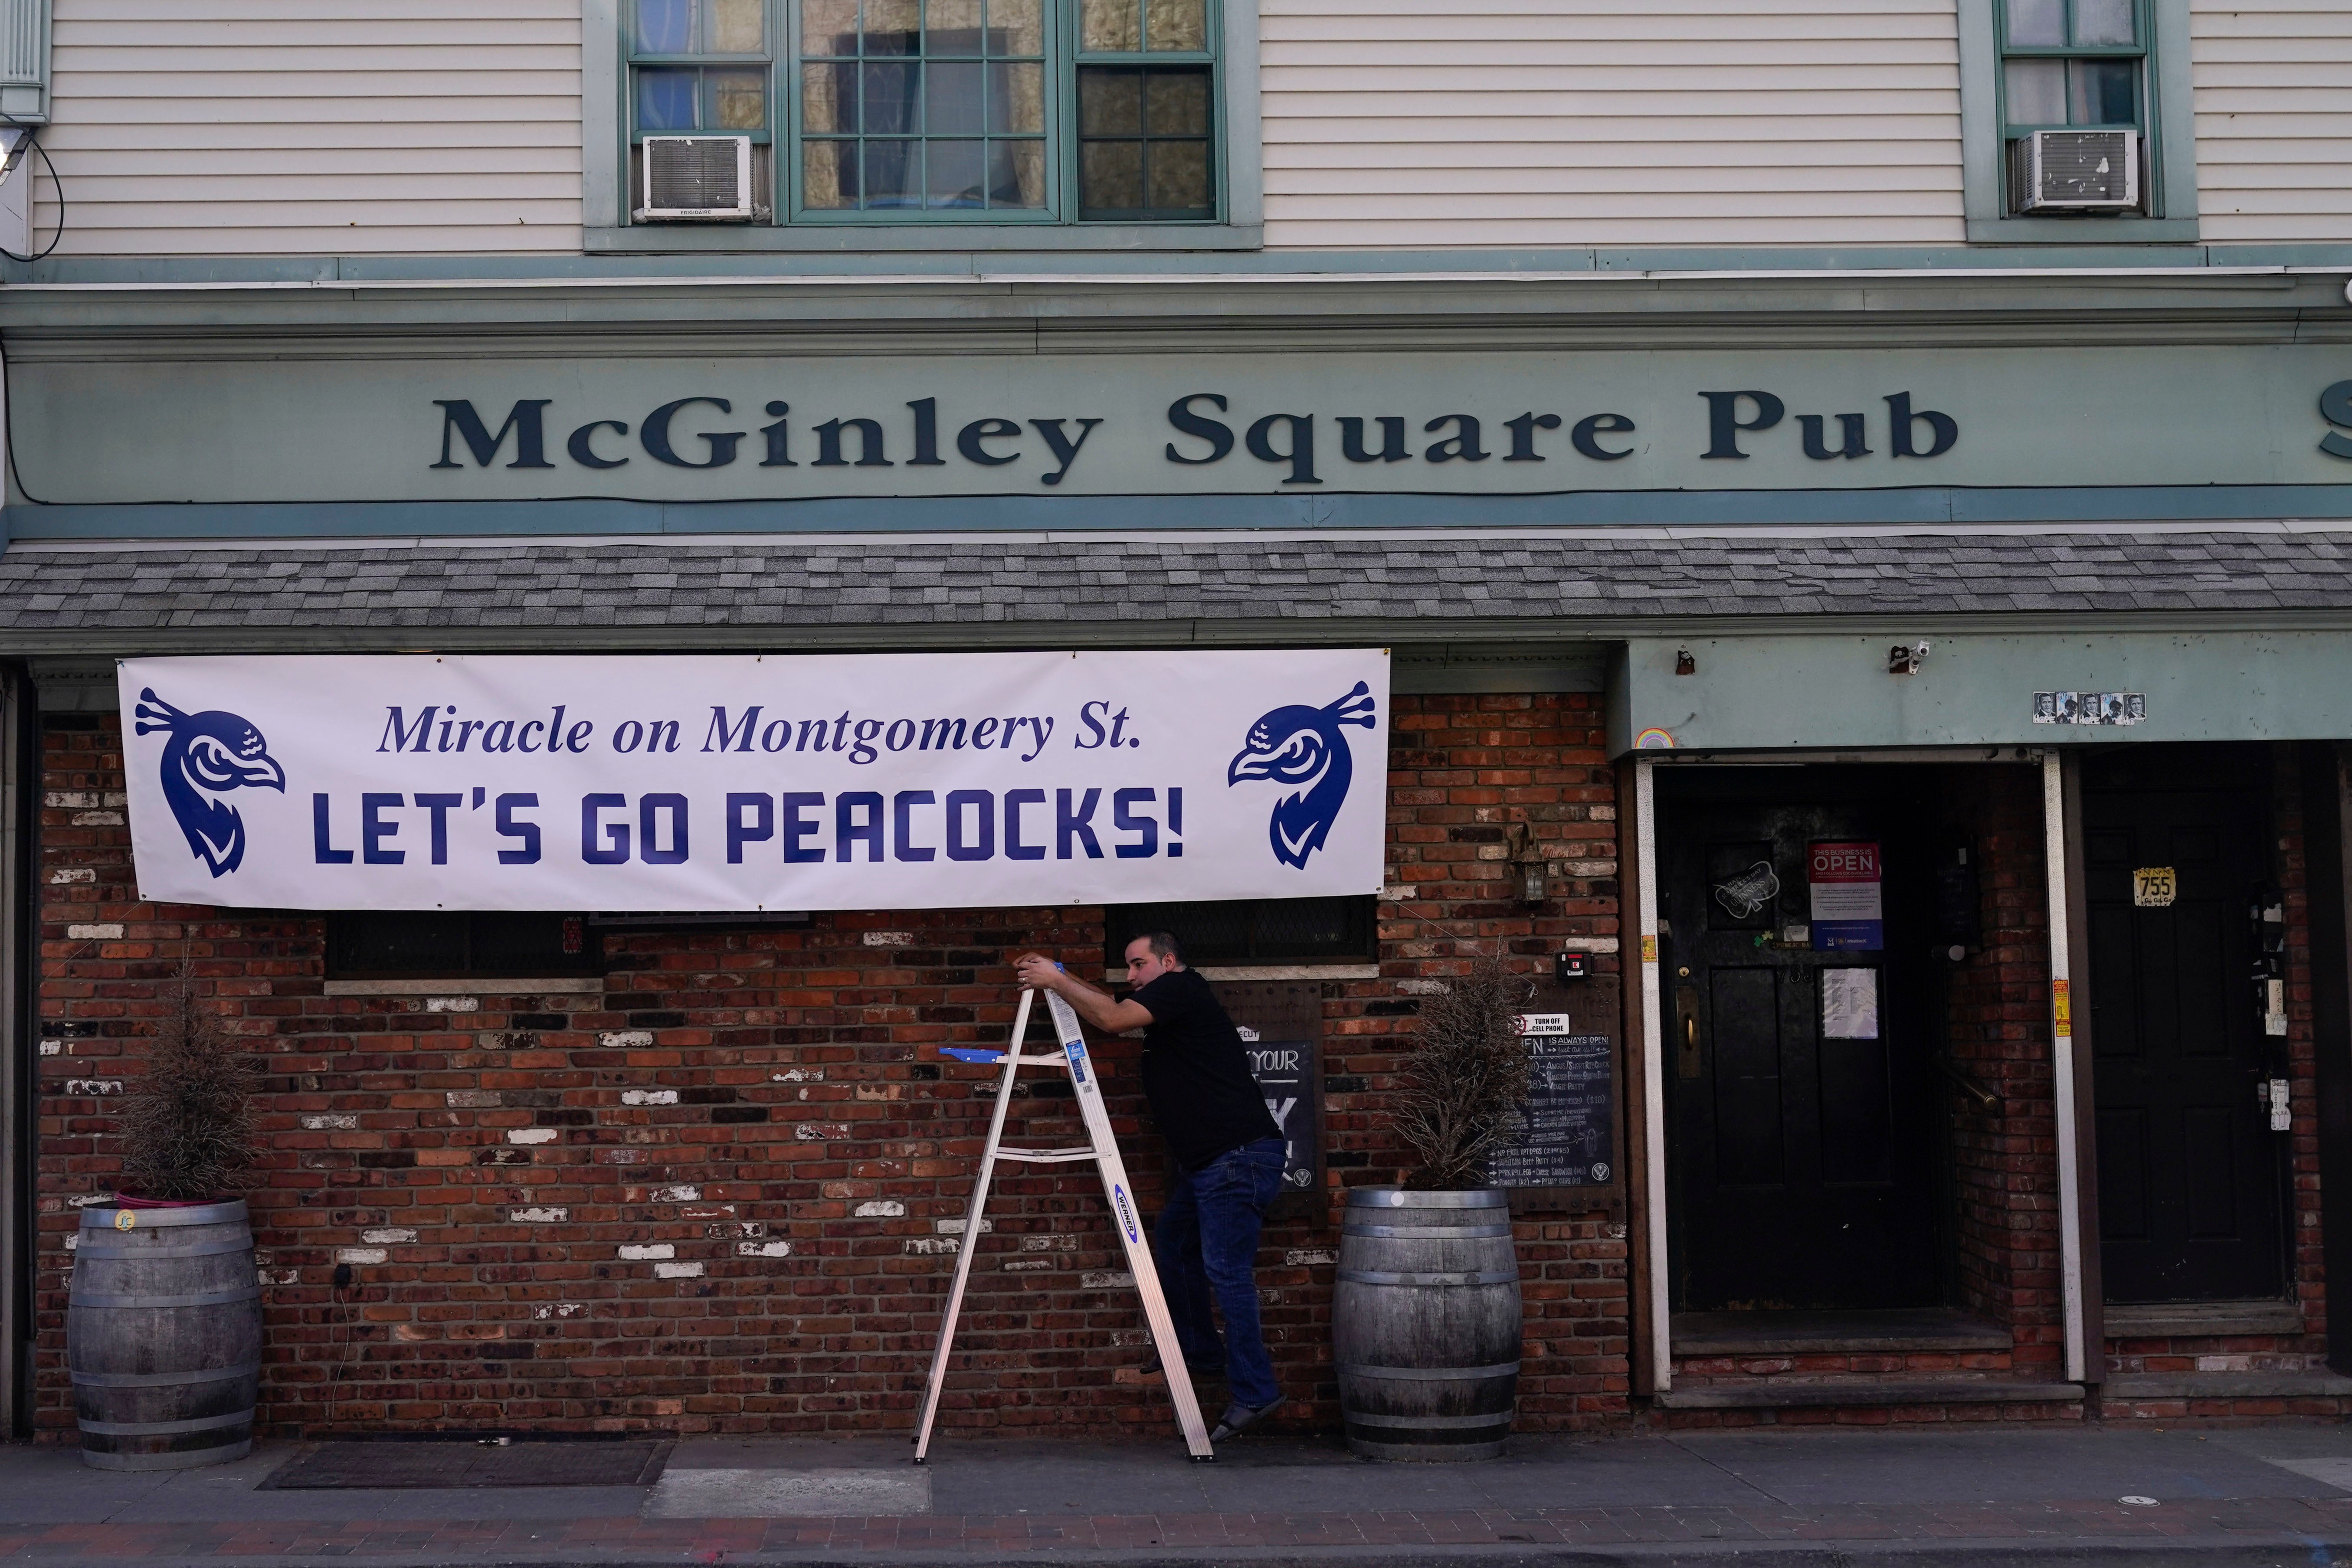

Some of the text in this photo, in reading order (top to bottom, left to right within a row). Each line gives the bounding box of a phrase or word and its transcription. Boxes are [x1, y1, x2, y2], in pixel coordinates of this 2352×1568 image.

[429, 390, 1958, 486] McGinley Square Pub
[376, 701, 1140, 764] Miracle on Montgomery St.
[313, 787, 1183, 865] LET'S GO PEACOCKS!
[1750, 867, 1762, 877] DAY
[1814, 855, 1873, 871] OPEN
[1730, 878, 1766, 906] GUINNESS
[2141, 877, 2170, 896] 755
[1779, 965, 1814, 983] 755
[1252, 1050, 1299, 1072] YOUR
[1587, 1094, 1605, 1104] ($10)
[1518, 1177, 1530, 1186] ($2)
[1119, 1196, 1134, 1231] WERNER
